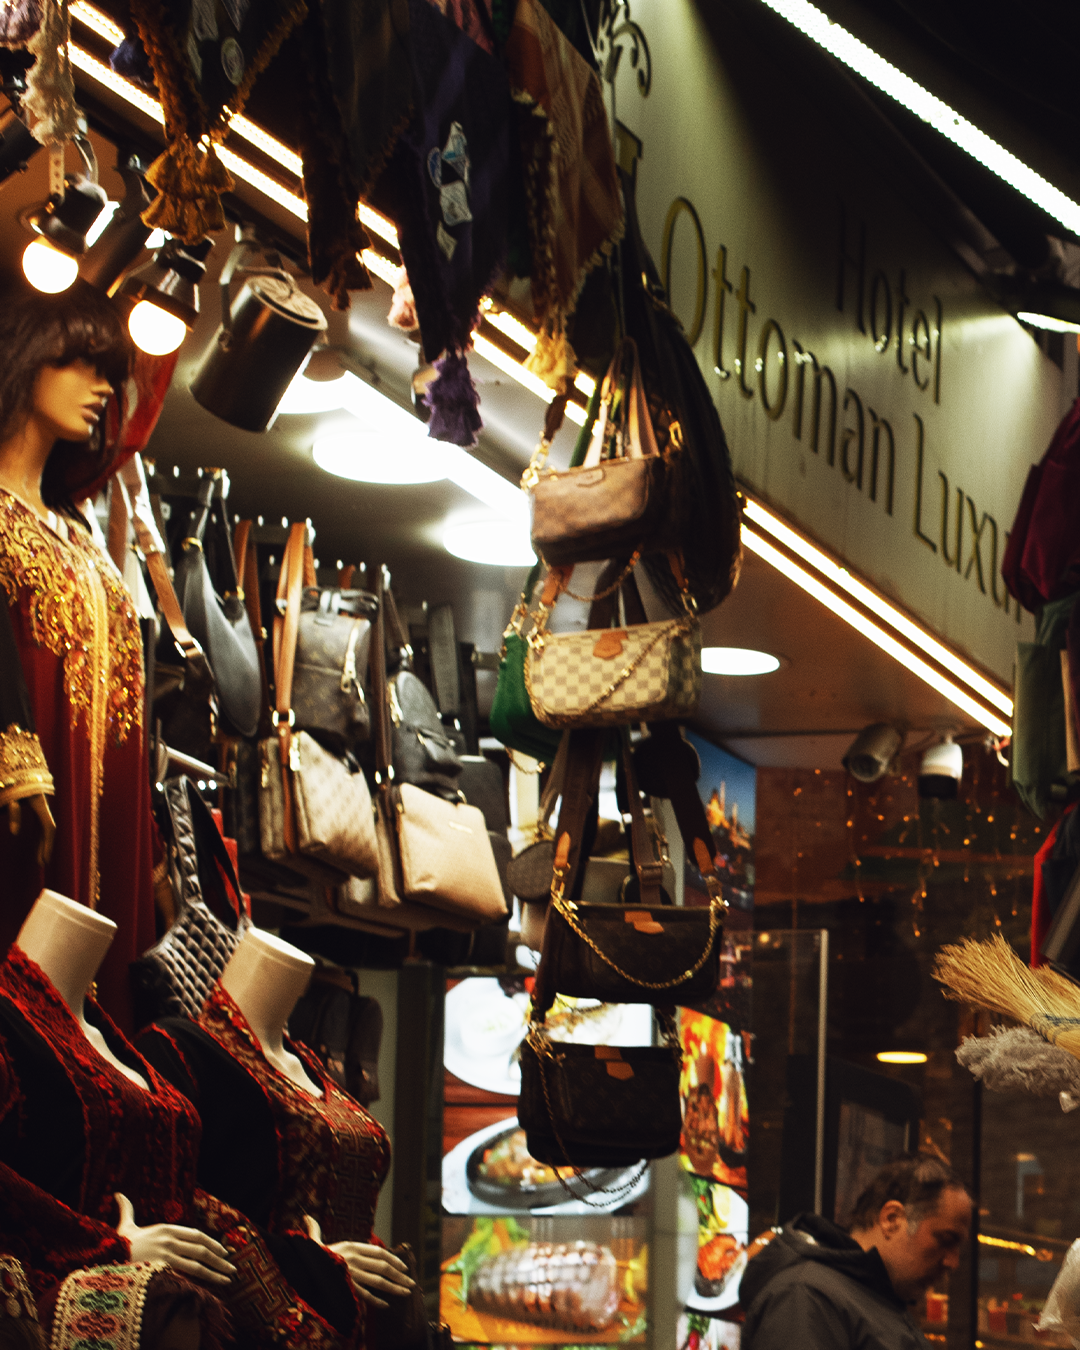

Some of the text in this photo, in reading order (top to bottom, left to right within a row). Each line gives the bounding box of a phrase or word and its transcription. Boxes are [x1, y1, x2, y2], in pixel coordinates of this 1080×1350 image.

[661, 197, 894, 517] Ottoman
[911, 412, 1023, 624] Luxu
[836, 199, 944, 405] Hotel
